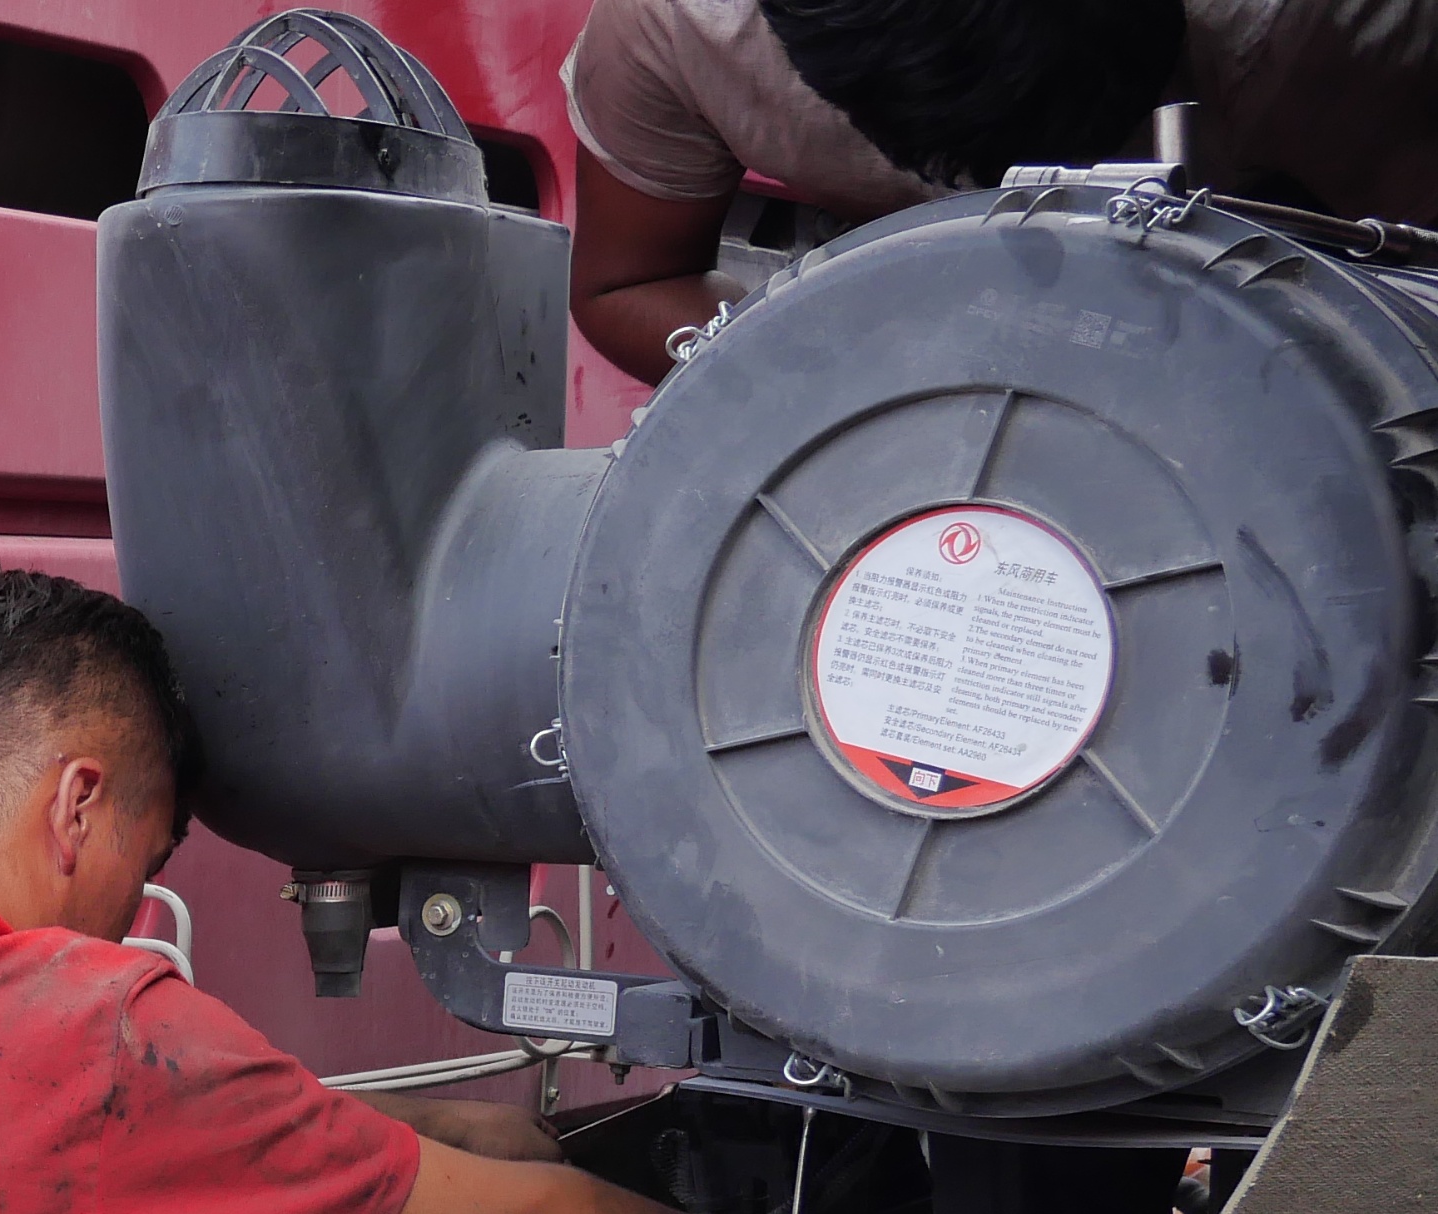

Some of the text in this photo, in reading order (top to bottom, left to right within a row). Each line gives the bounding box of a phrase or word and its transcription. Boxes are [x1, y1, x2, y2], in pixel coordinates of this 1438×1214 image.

[994, 560, 1058, 587] 东风商用车
[998, 587, 1045, 604] Maintenance
[971, 615, 999, 626] cleaned
[1007, 601, 1018, 609] the
[1020, 604, 1058, 618] restriction
[1060, 613, 1093, 626] indicator
[1013, 614, 1041, 626] primary
[1043, 620, 1071, 632] element
[1072, 627, 1090, 636] must
[962, 646, 991, 659] primary
[975, 637, 984, 645] be
[986, 640, 1013, 651] cleaned
[1016, 647, 1035, 656] when
[1036, 652, 1068, 666] cleaning
[1070, 659, 1083, 667] the
[989, 630, 1024, 644] secondary
[1026, 638, 1053, 650] element
[1079, 651, 1096, 659] need
[957, 666, 984, 678] cleaned
[986, 674, 1005, 683] more
[1007, 677, 1022, 686] than
[1024, 681, 1043, 691] three
[1045, 686, 1065, 696] times
[989, 662, 1018, 676] primary
[1020, 670, 1050, 682] element
[1052, 677, 1064, 685] has
[1066, 680, 1084, 689] been
[953, 676, 1087, 712] restriction indicator still signals after
[948, 697, 980, 709] elements
[982, 704, 1006, 715] should
[1008, 710, 1017, 718] be
[1018, 713, 1050, 727] replaced
[1051, 721, 1061, 730] by
[984, 694, 1000, 703] both
[1001, 698, 1030, 711] primary
[1031, 705, 1045, 713] and
[1046, 708, 1083, 724] secondary
[911, 771, 937, 788] 向下
